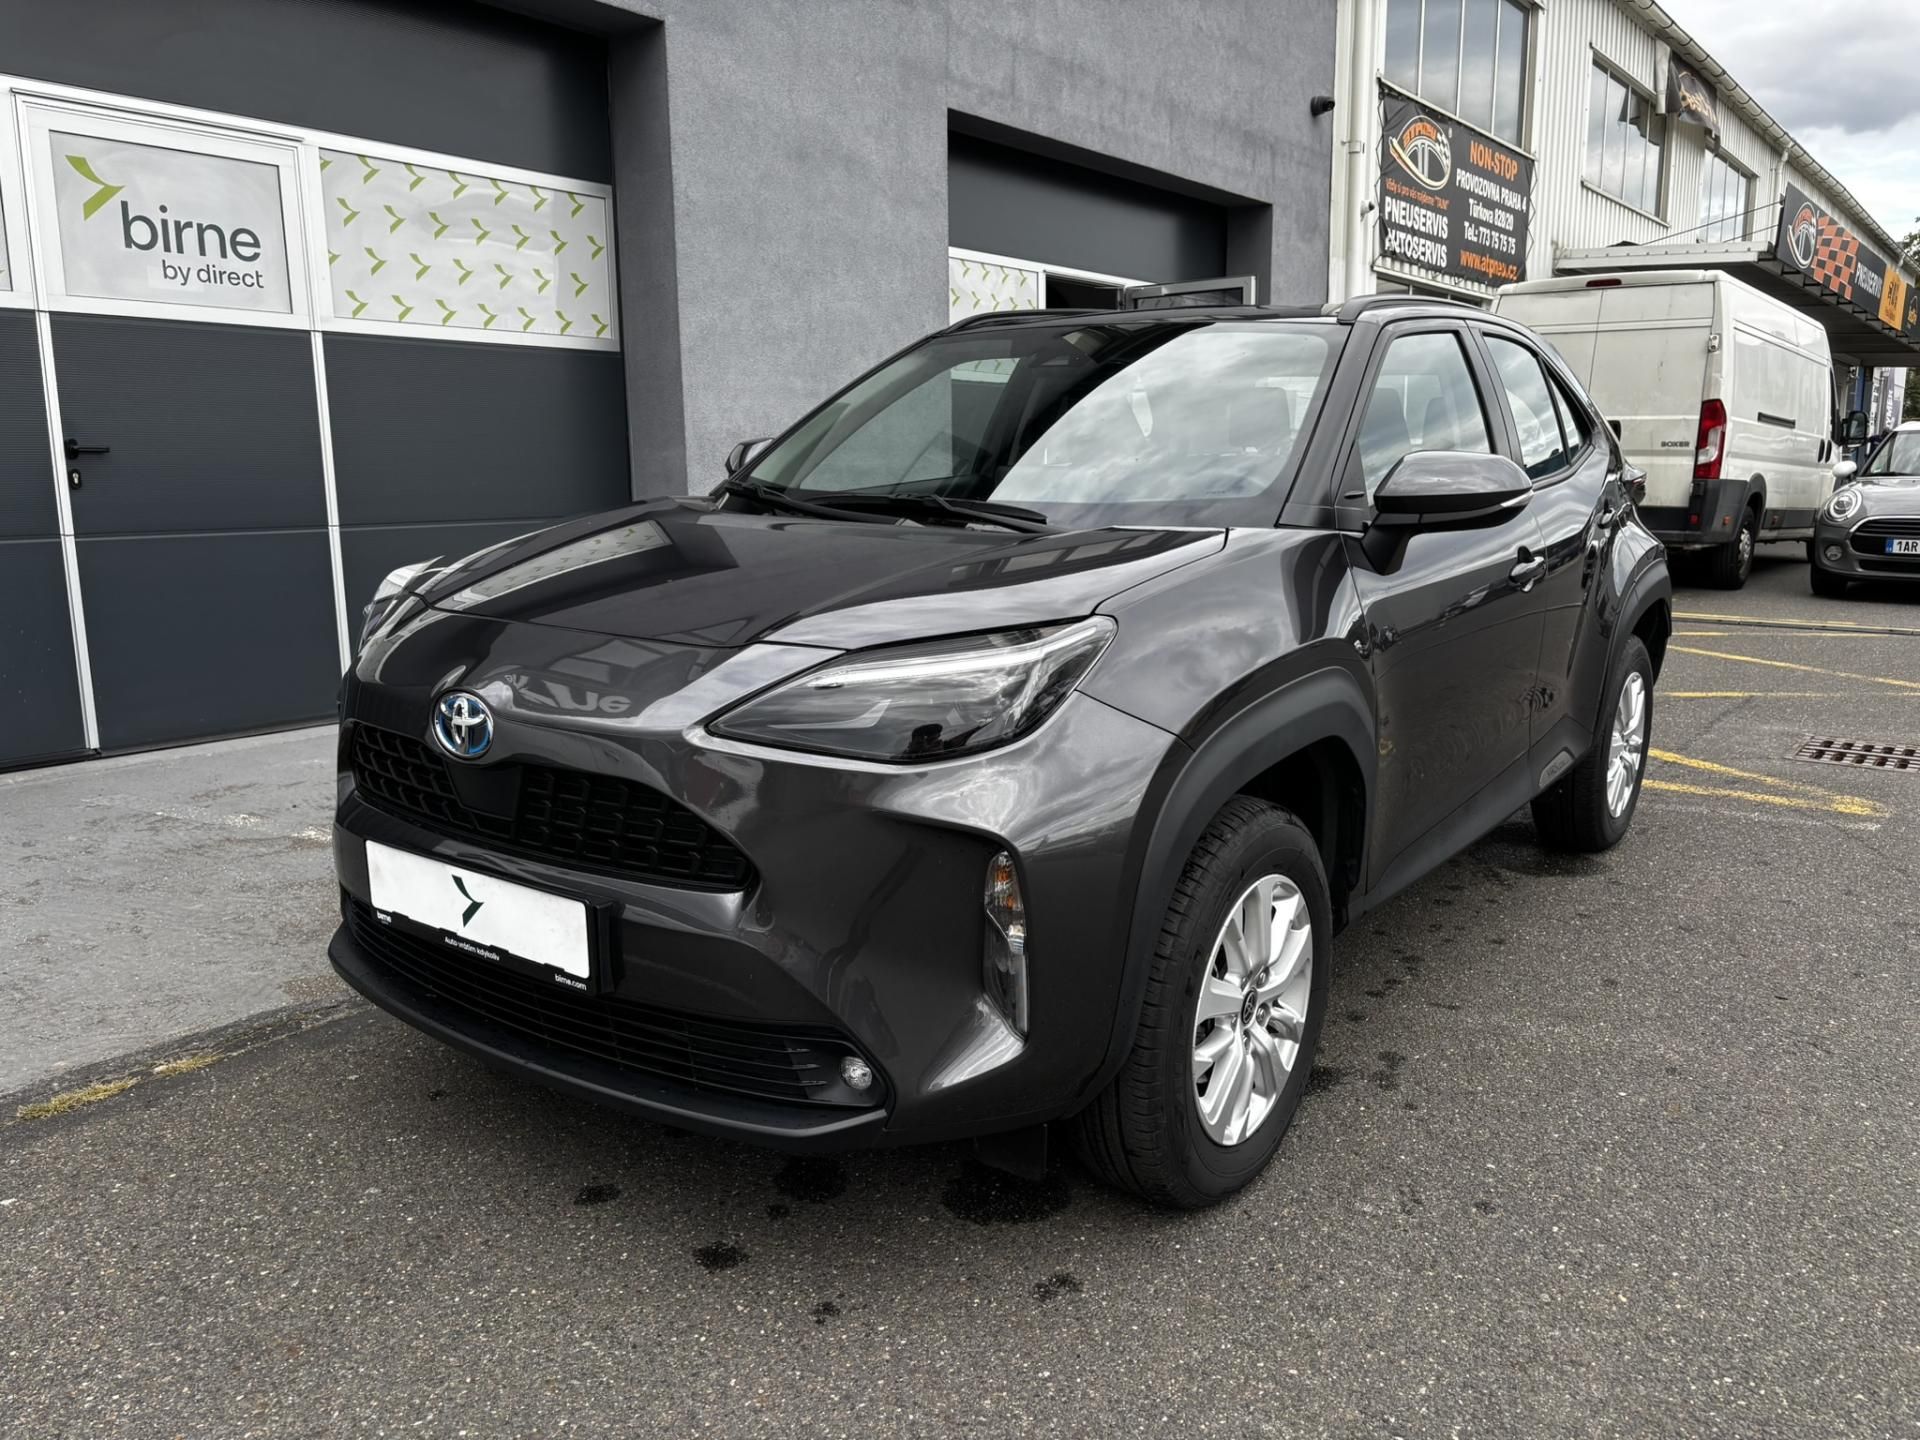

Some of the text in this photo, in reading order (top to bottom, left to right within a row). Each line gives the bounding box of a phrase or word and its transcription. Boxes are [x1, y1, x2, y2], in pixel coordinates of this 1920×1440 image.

[1470, 140, 1518, 182] NON-STOP
[1456, 168, 1500, 203] PROVOZOVNA
[1500, 187, 1522, 211] PRAHA
[1522, 196, 1527, 213] 4
[121, 200, 261, 262] birne
[1385, 196, 1449, 239] PNEUSERVIS
[1385, 228, 1448, 268] AUTOSERVIS
[1478, 226, 1490, 246] 773
[1491, 230, 1499, 250] 75
[1499, 234, 1507, 254] 75
[1507, 237, 1516, 256] 75
[162, 259, 264, 288] by direct
[1897, 541, 1918, 552] 1AR
